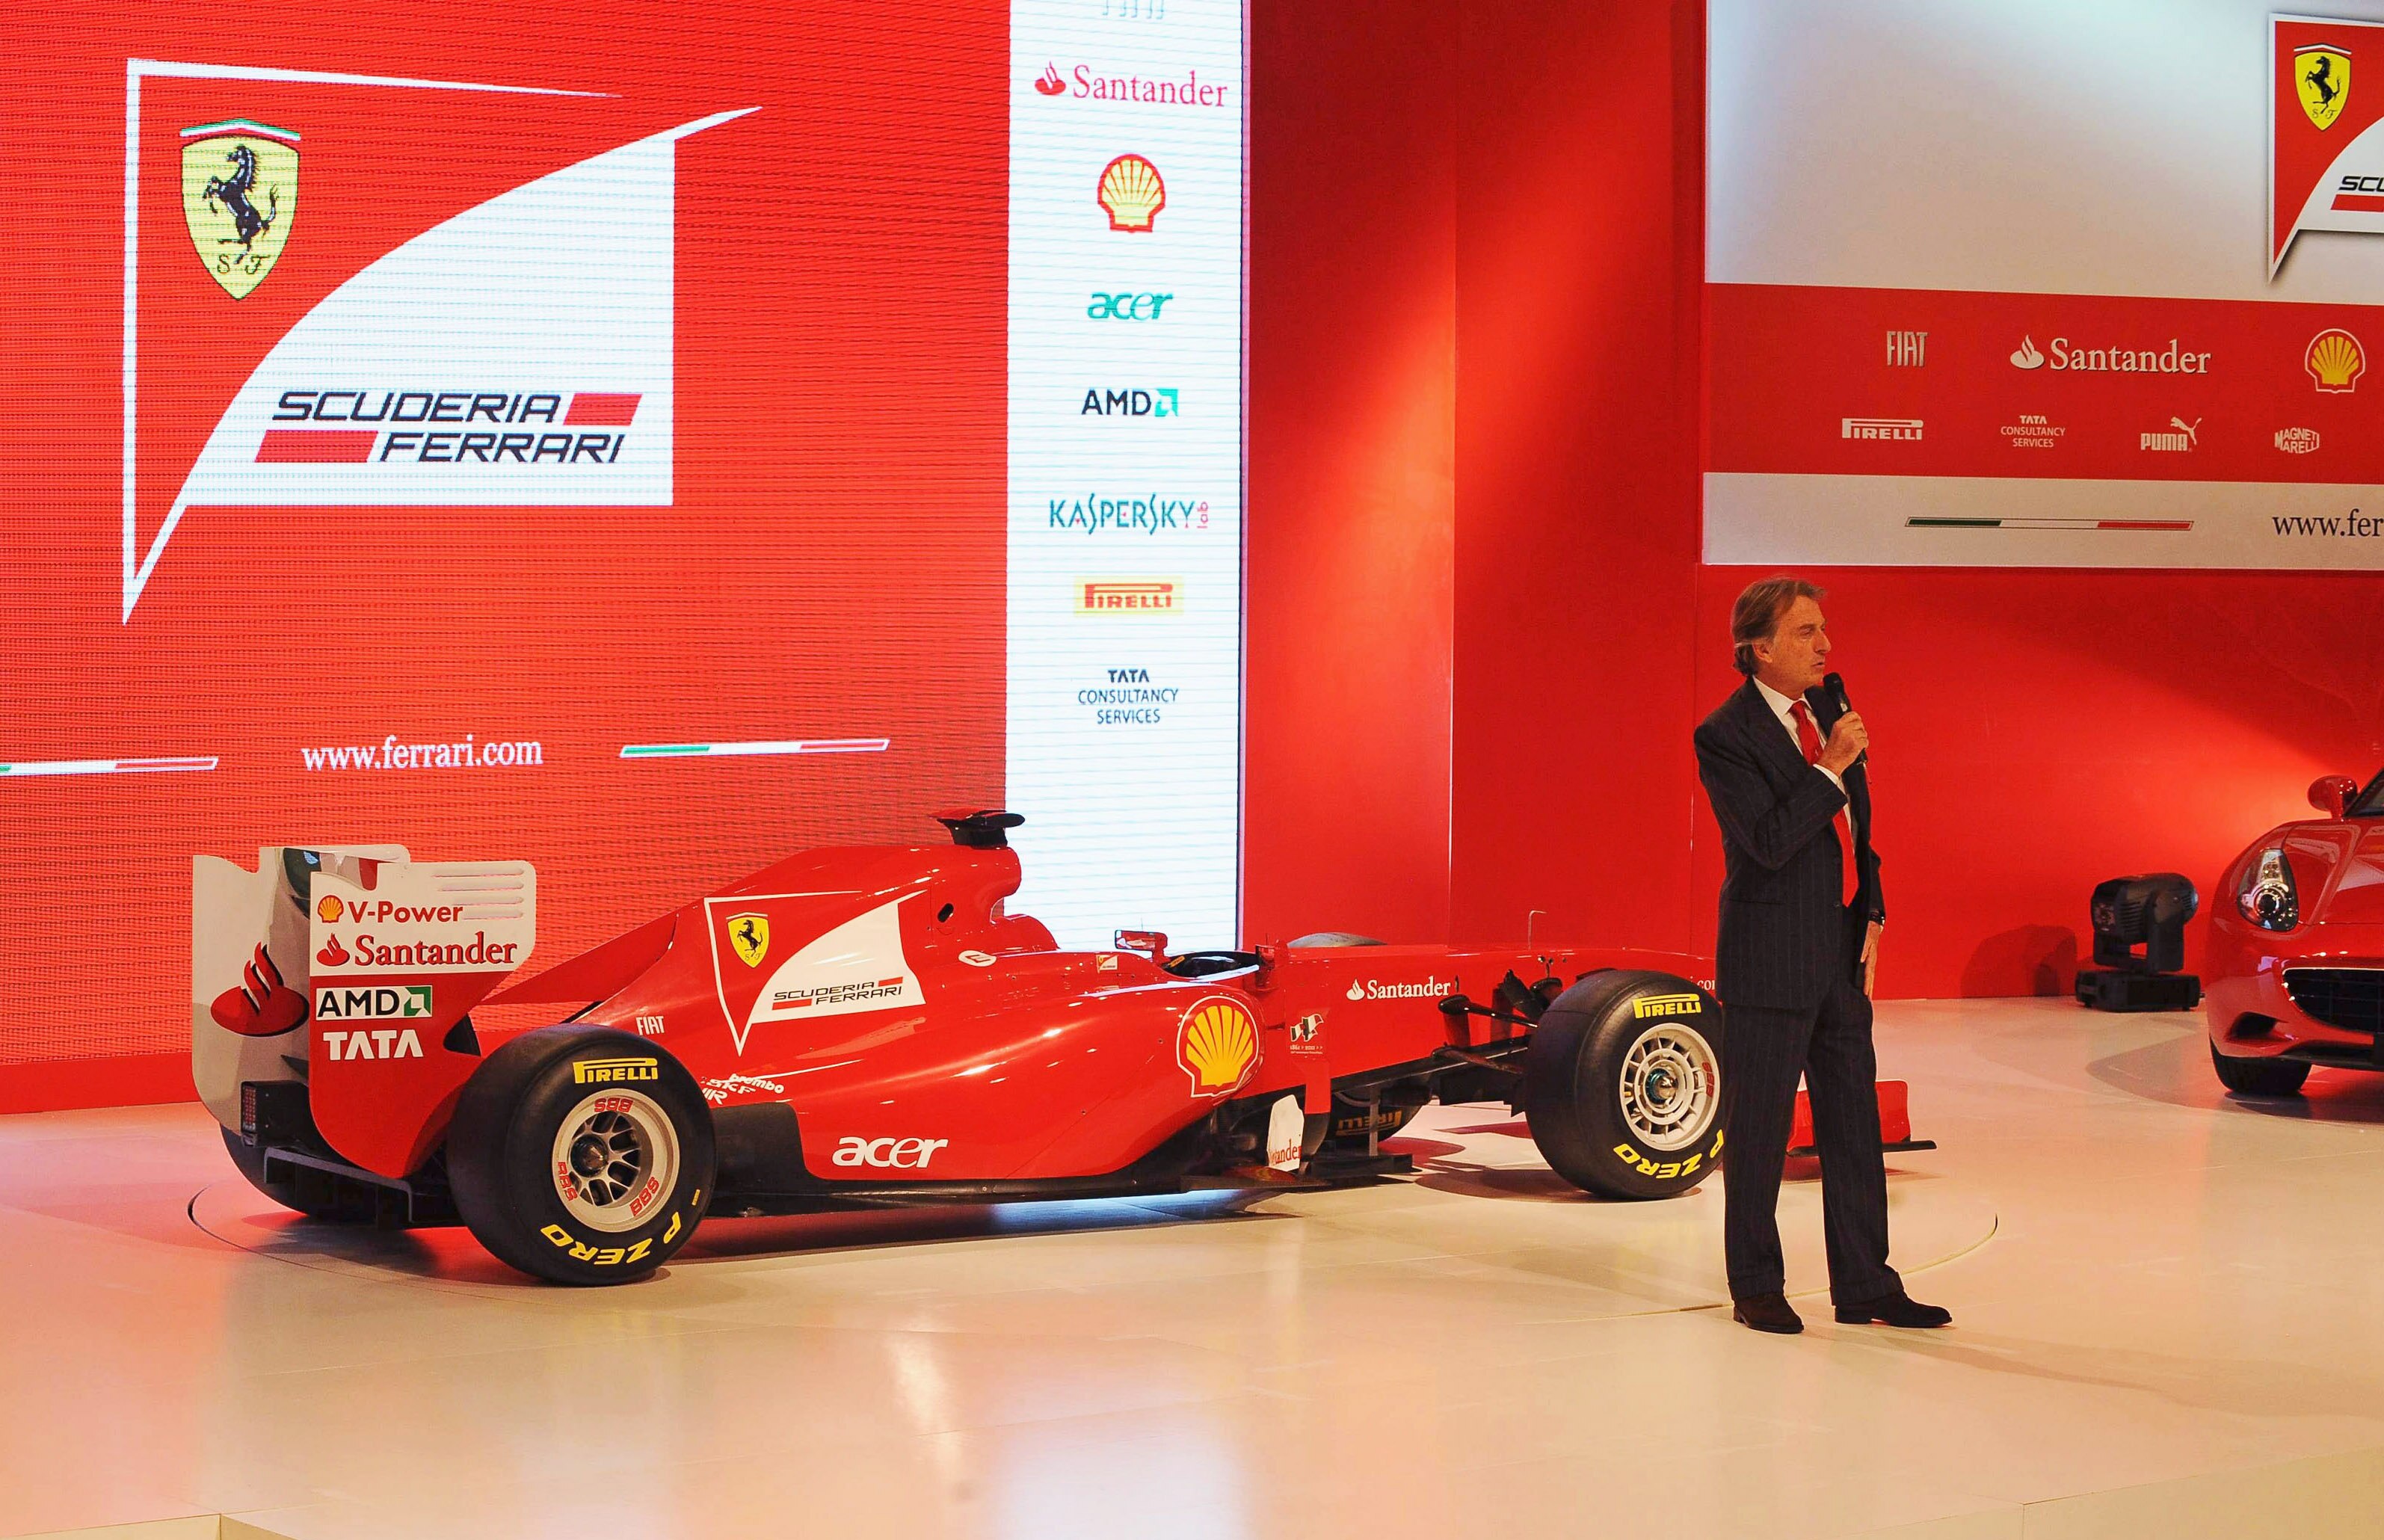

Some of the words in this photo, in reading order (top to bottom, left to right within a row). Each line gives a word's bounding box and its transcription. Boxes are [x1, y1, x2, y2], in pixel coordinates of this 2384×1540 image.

[1073, 64, 1228, 107] Santander
[217, 254, 230, 274] S
[1087, 292, 1174, 321] acer
[1887, 331, 1927, 367] FIAT
[2050, 338, 2211, 374] Santander
[273, 392, 562, 422] SCUDERIA
[1082, 389, 1151, 416] AMD
[1842, 419, 1923, 440] PIRELLI
[2000, 425, 2066, 438] CONSULTANCY
[2020, 416, 2047, 424] TATA
[380, 434, 626, 463] FERRARI
[2012, 437, 2054, 448] SERVICES
[2140, 433, 2188, 452] PUMA
[1050, 493, 1195, 535] KASPERSKY
[2272, 508, 2384, 537] www.fer
[1085, 583, 1174, 609] PIRELLI
[1108, 669, 1150, 683] TATA
[1078, 689, 1179, 705] CONSULTANCY
[1097, 709, 1160, 724] SERVICES
[301, 734, 543, 771] www.ferrari.com
[348, 901, 463, 923] V-Power
[355, 931, 518, 967] Santander
[773, 982, 875, 1000] SCUDERIA
[816, 986, 902, 1005] FERRARI
[1367, 975, 1451, 1000] Santander
[318, 990, 400, 1017] AMD
[1633, 994, 1701, 1018] PIRELLI
[636, 1016, 665, 1035] FIAT
[323, 1029, 424, 1061] TATA
[573, 1058, 658, 1083] PIRELLI
[594, 1097, 633, 1113] BBS
[832, 1137, 949, 1168] acer
[1710, 1129, 1725, 1159] P
[1613, 1143, 1703, 1179] ZERO
[629, 1176, 659, 1216] BBS
[663, 1211, 681, 1244] P
[540, 1224, 653, 1265] ZERO
